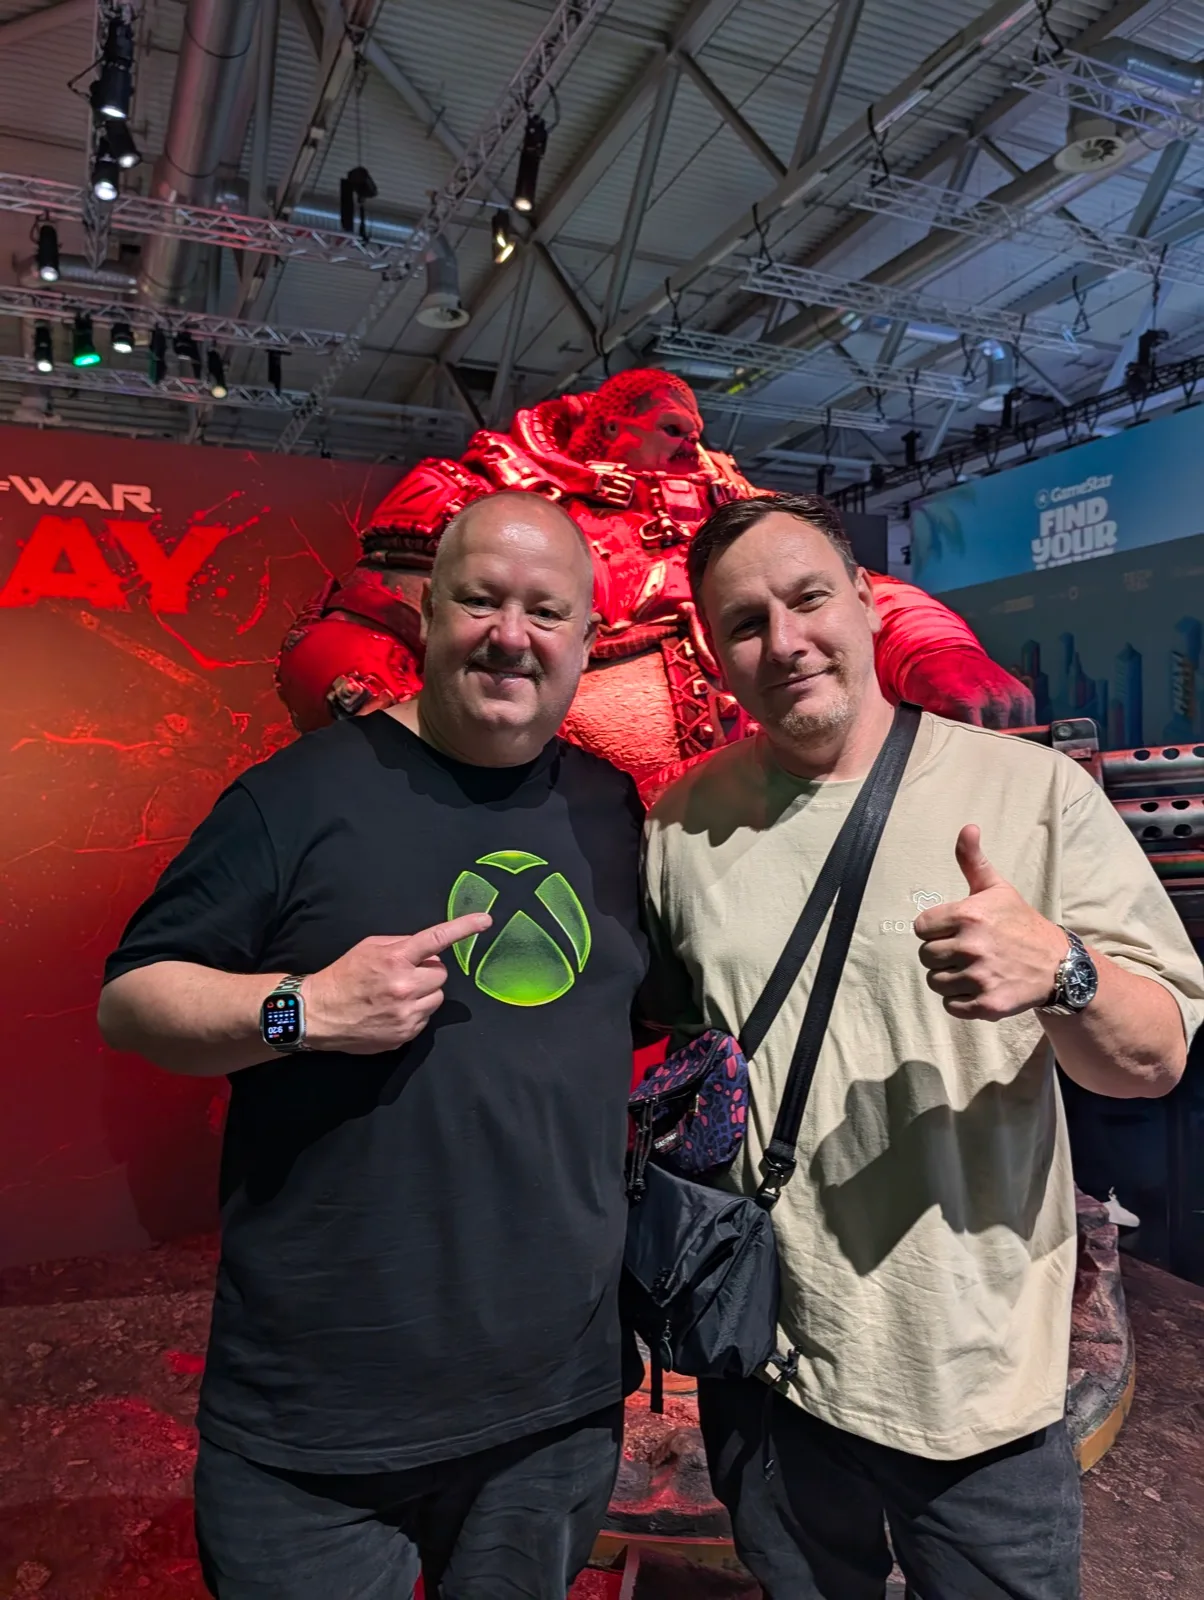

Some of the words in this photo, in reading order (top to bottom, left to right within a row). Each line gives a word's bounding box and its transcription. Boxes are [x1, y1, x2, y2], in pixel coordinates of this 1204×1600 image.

[8, 475, 156, 513] WAR
[1040, 496, 1108, 537] FIND
[1031, 520, 1117, 563] YOUR
